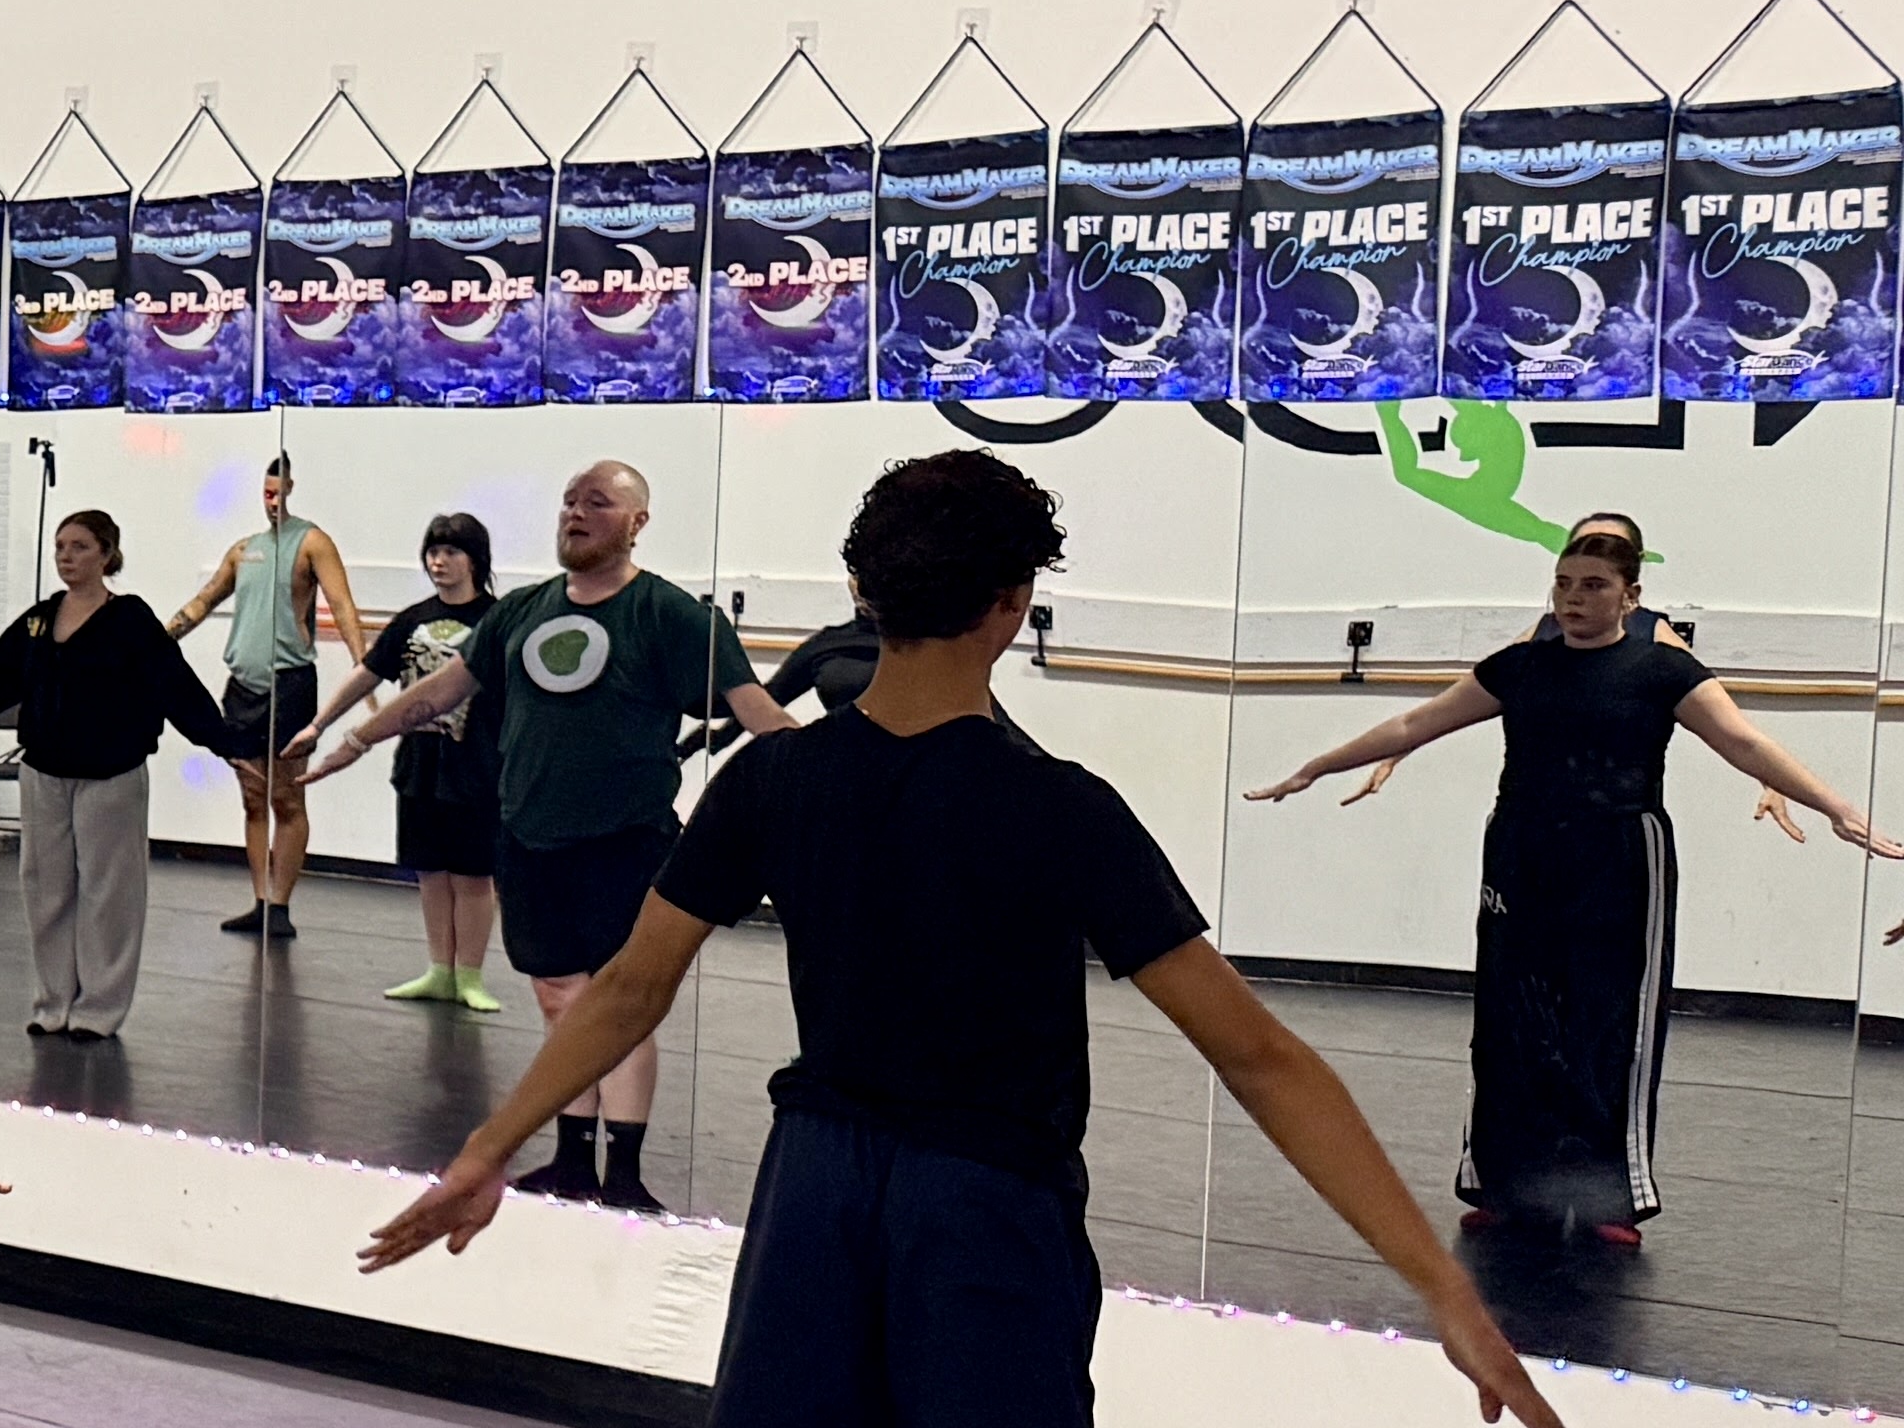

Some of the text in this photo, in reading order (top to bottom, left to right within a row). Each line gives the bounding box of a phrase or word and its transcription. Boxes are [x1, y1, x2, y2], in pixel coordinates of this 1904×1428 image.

[1063, 212, 1230, 252] 1ST PLACE
[1251, 202, 1428, 249] 1ST PLACE
[1463, 197, 1653, 245] 1ST PLACE
[1682, 187, 1889, 235] 1ST PLACE
[882, 218, 1037, 261] 1ST PLACE
[1479, 233, 1632, 286] Champion
[1702, 223, 1865, 279] Champion
[604, 267, 690, 292] PLACE
[770, 257, 867, 285] PLACE
[899, 250, 1020, 299] Champion
[1079, 241, 1211, 291] Champion
[1267, 237, 1406, 289] Champion
[44, 289, 115, 313] PLACE
[171, 288, 246, 313] PLACE
[302, 279, 386, 302] PLACE
[451, 277, 535, 302] PLACE
